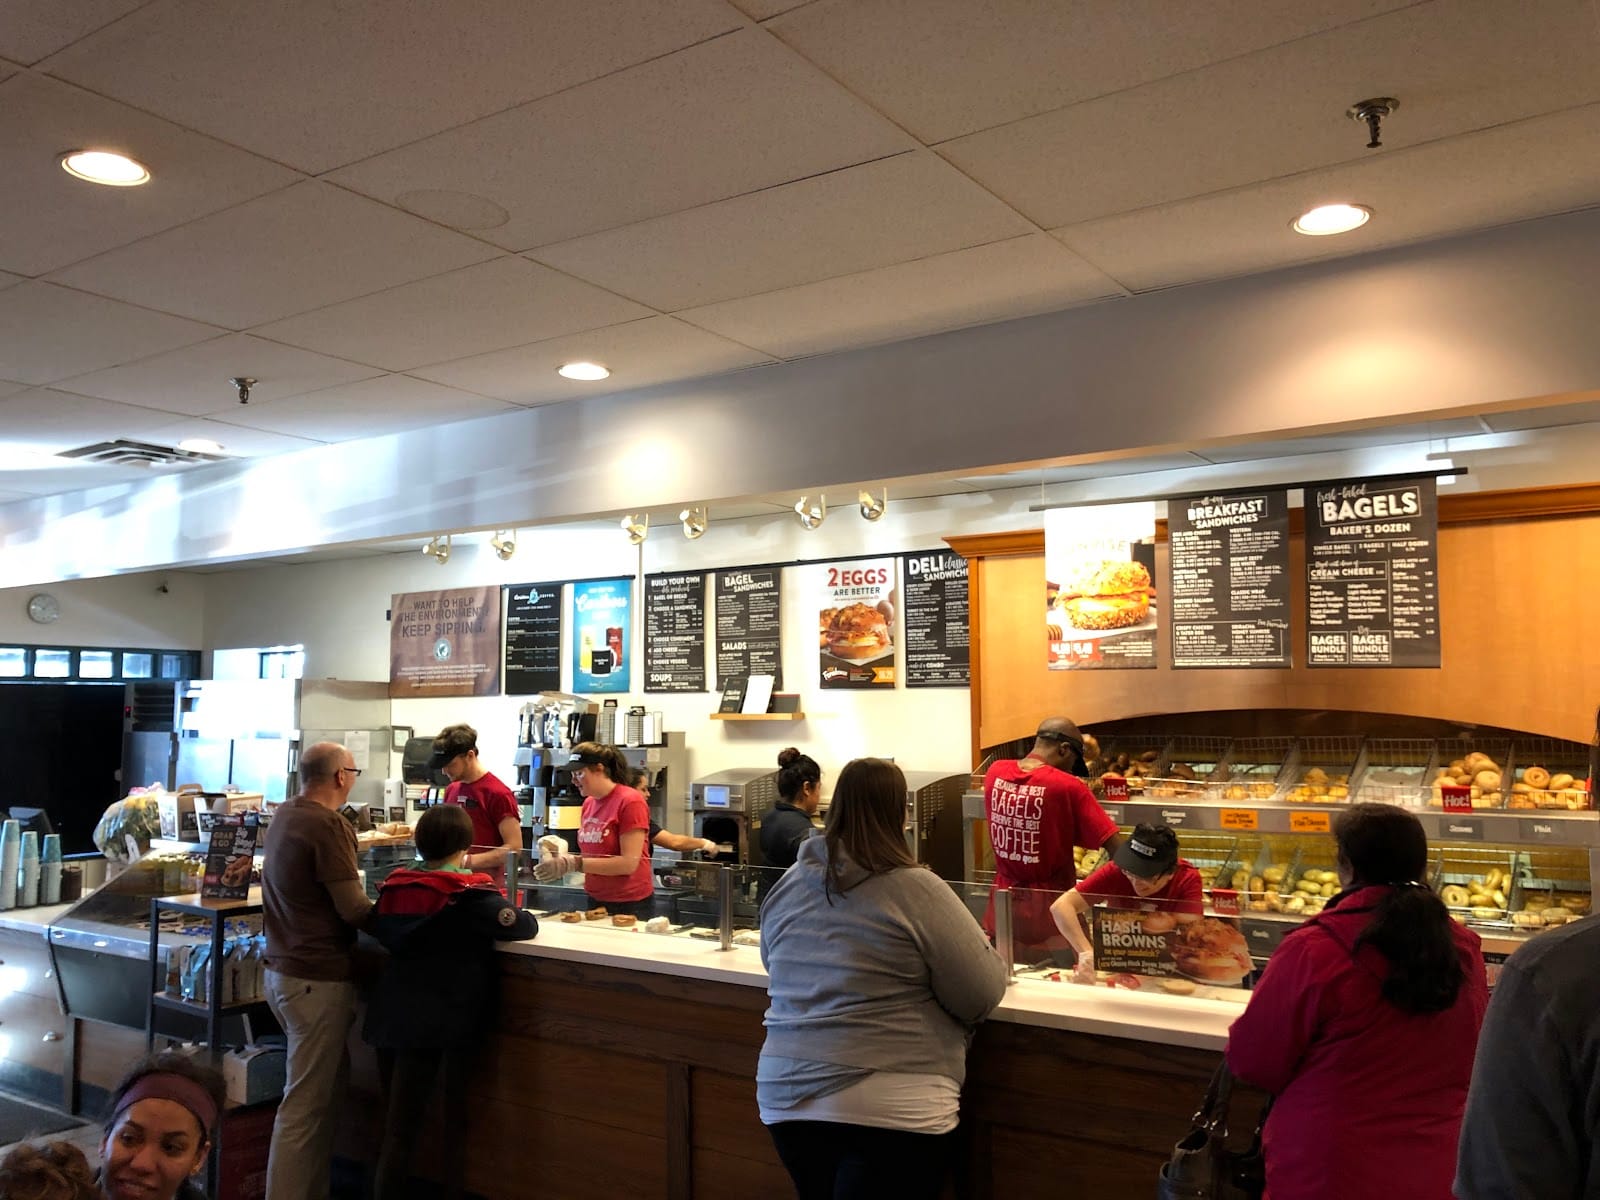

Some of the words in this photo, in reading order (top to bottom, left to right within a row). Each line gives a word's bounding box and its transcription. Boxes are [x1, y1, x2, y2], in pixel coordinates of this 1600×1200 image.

[1187, 499, 1264, 521] BREAKFAST
[1322, 492, 1418, 522] BAGELS
[1195, 513, 1258, 529] SANDWICHES
[1329, 525, 1372, 536] BAKER'S
[1374, 523, 1411, 533] DOZEN
[908, 555, 944, 576] DELI
[1310, 569, 1340, 577] CREAM
[1342, 567, 1374, 576] CHEESE
[651, 579, 668, 587] BUILD
[668, 577, 685, 585] YOUR
[724, 573, 754, 587] BAGEL
[827, 567, 838, 587] 2
[841, 568, 887, 586] EGGS
[733, 580, 774, 593] SANDWICHES
[833, 588, 849, 596] ARE
[851, 586, 881, 595] BETTER
[413, 600, 436, 610] WANT
[439, 599, 450, 609] TO
[452, 597, 474, 607] HELP
[400, 612, 416, 622] THE
[402, 624, 431, 638] KEEP
[721, 641, 747, 650] SALADS
[1311, 635, 1347, 645] BAGEL
[1352, 634, 1389, 645] BAGEL
[1311, 645, 1346, 653] BUNDLE
[1352, 644, 1389, 653] BUNDLE
[650, 673, 673, 682] SOUPS
[994, 777, 1018, 794] BECAUSE
[1018, 785, 1029, 796] THE
[1029, 786, 1047, 797] BEST
[1106, 784, 1127, 796] Hot!
[991, 788, 1044, 820] BAGELS
[1444, 794, 1470, 808] Hot!
[1013, 817, 1025, 829] THE
[1025, 820, 1041, 830] BEST
[991, 822, 1041, 854] COFFEE
[1214, 897, 1237, 908] Hot!
[1101, 919, 1142, 934] HASH
[1102, 933, 1167, 949] BROWNS
